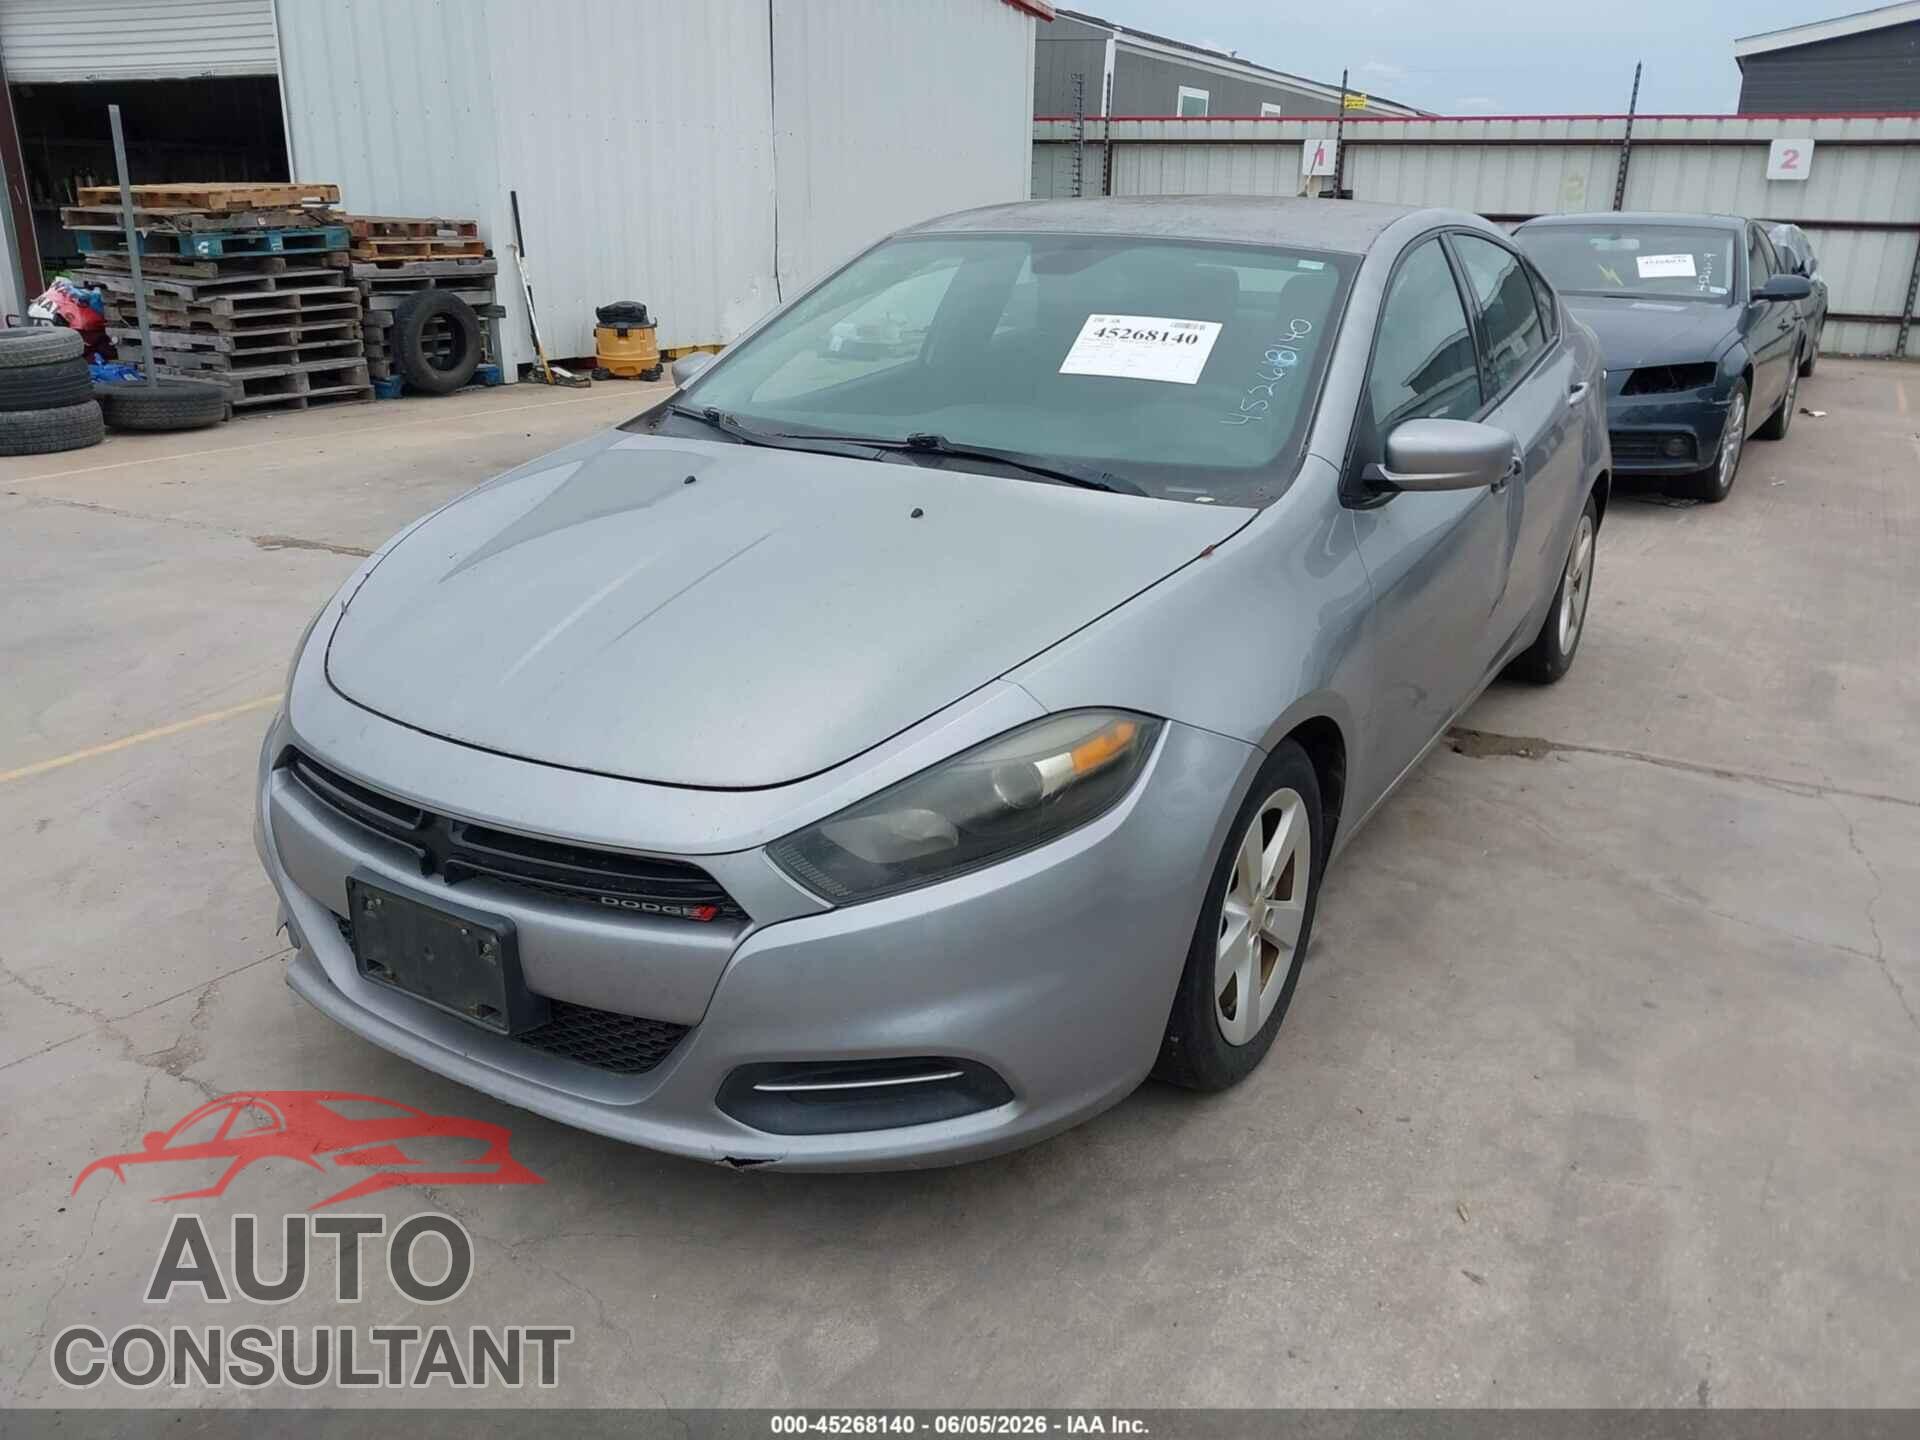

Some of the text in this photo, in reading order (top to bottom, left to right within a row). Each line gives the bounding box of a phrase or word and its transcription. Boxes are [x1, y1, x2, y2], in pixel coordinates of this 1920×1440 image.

[1781, 149, 1800, 169] 2
[1092, 326, 1199, 345] 45268140
[1219, 318, 1312, 425] 45268140
[600, 896, 701, 920] DODGE
